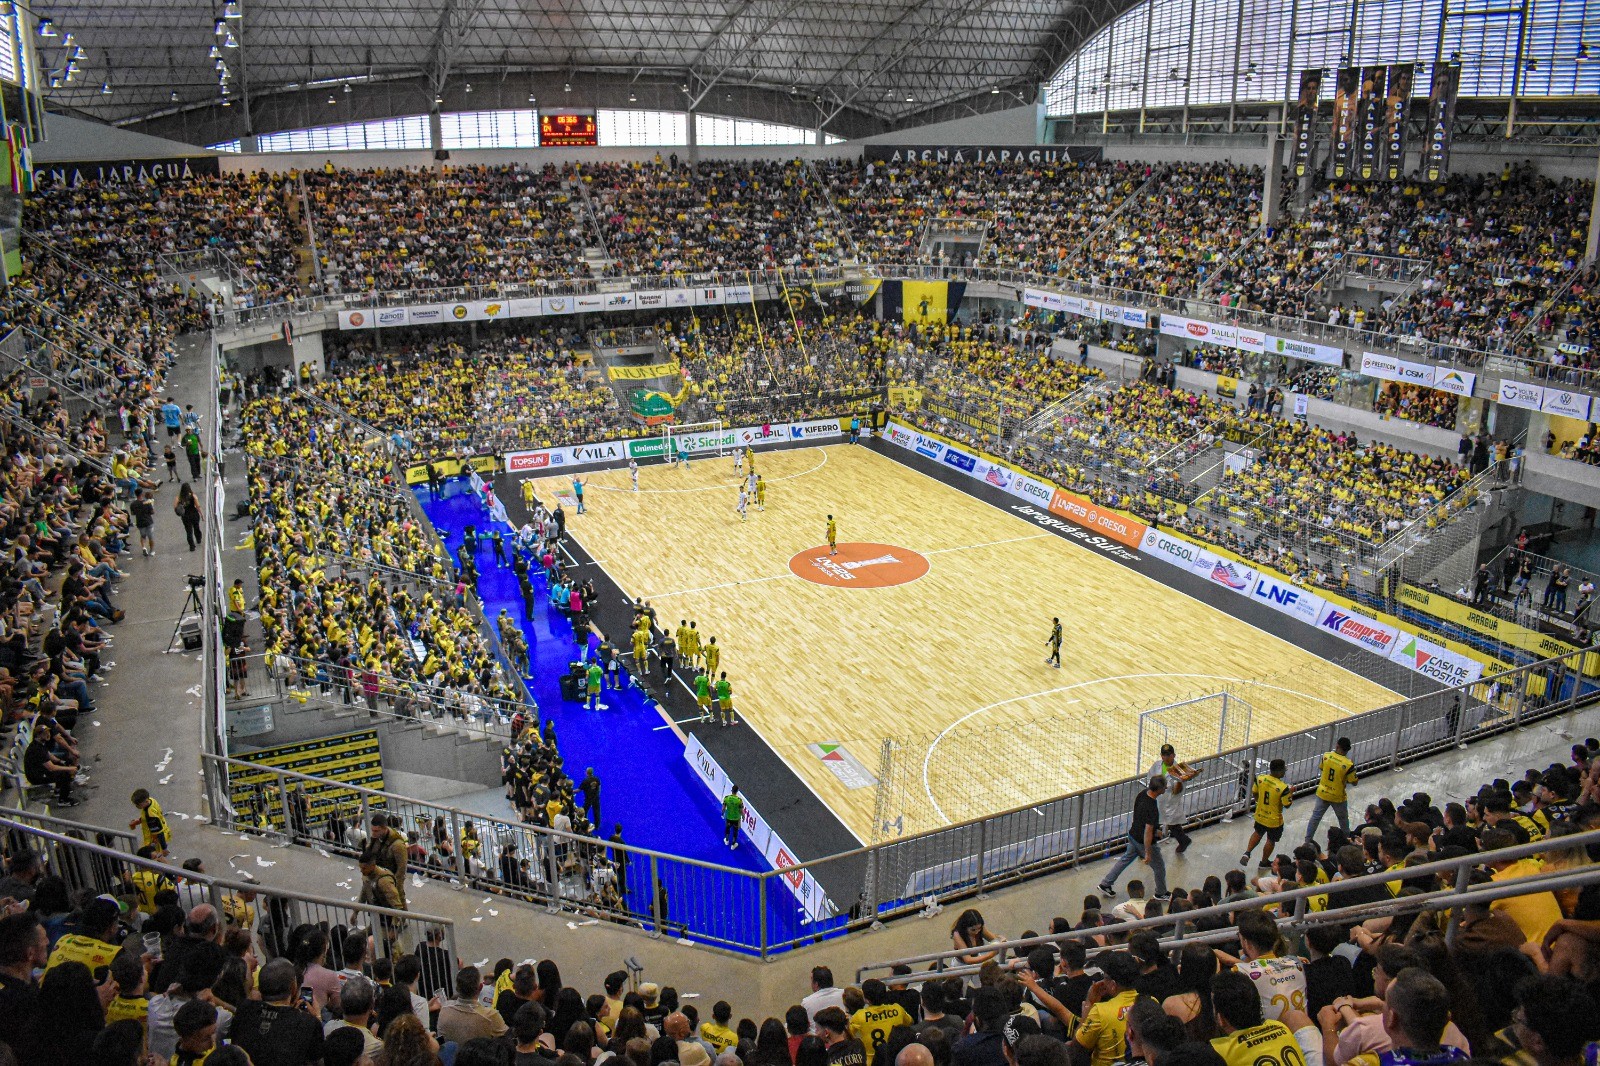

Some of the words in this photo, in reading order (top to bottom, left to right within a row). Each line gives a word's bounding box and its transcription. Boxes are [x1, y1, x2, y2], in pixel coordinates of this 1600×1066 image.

[1431, 101, 1447, 151] TIAGO
[891, 149, 965, 163] ARENA
[976, 147, 1072, 163] JARAGUÁ
[1212, 328, 1236, 339] DALILA
[614, 364, 680, 379] NUNCA
[1406, 369, 1424, 379] CSM
[804, 424, 838, 434] KIFERRO
[634, 444, 663, 453] Unimed
[698, 434, 735, 448] Sicredi
[513, 456, 544, 466] TOPSUN
[585, 446, 616, 460] VILA
[1024, 482, 1051, 502] CRESOL
[1011, 504, 1082, 534] Jaraguá
[1084, 536, 1125, 552] Sul
[1098, 516, 1128, 536] CRESOL
[1158, 538, 1194, 563] CRESOL
[1256, 580, 1300, 606] LNF
[1400, 588, 1430, 606] JARAGUÁ
[1466, 612, 1499, 631] JARAGUÁ
[1538, 638, 1574, 660] JARAGUÁ
[1419, 664, 1464, 687] APOSTAS
[1428, 656, 1455, 674] CASA
[1454, 667, 1470, 679] DE
[702, 756, 715, 781] VILA
[870, 1028, 888, 1052] 8
